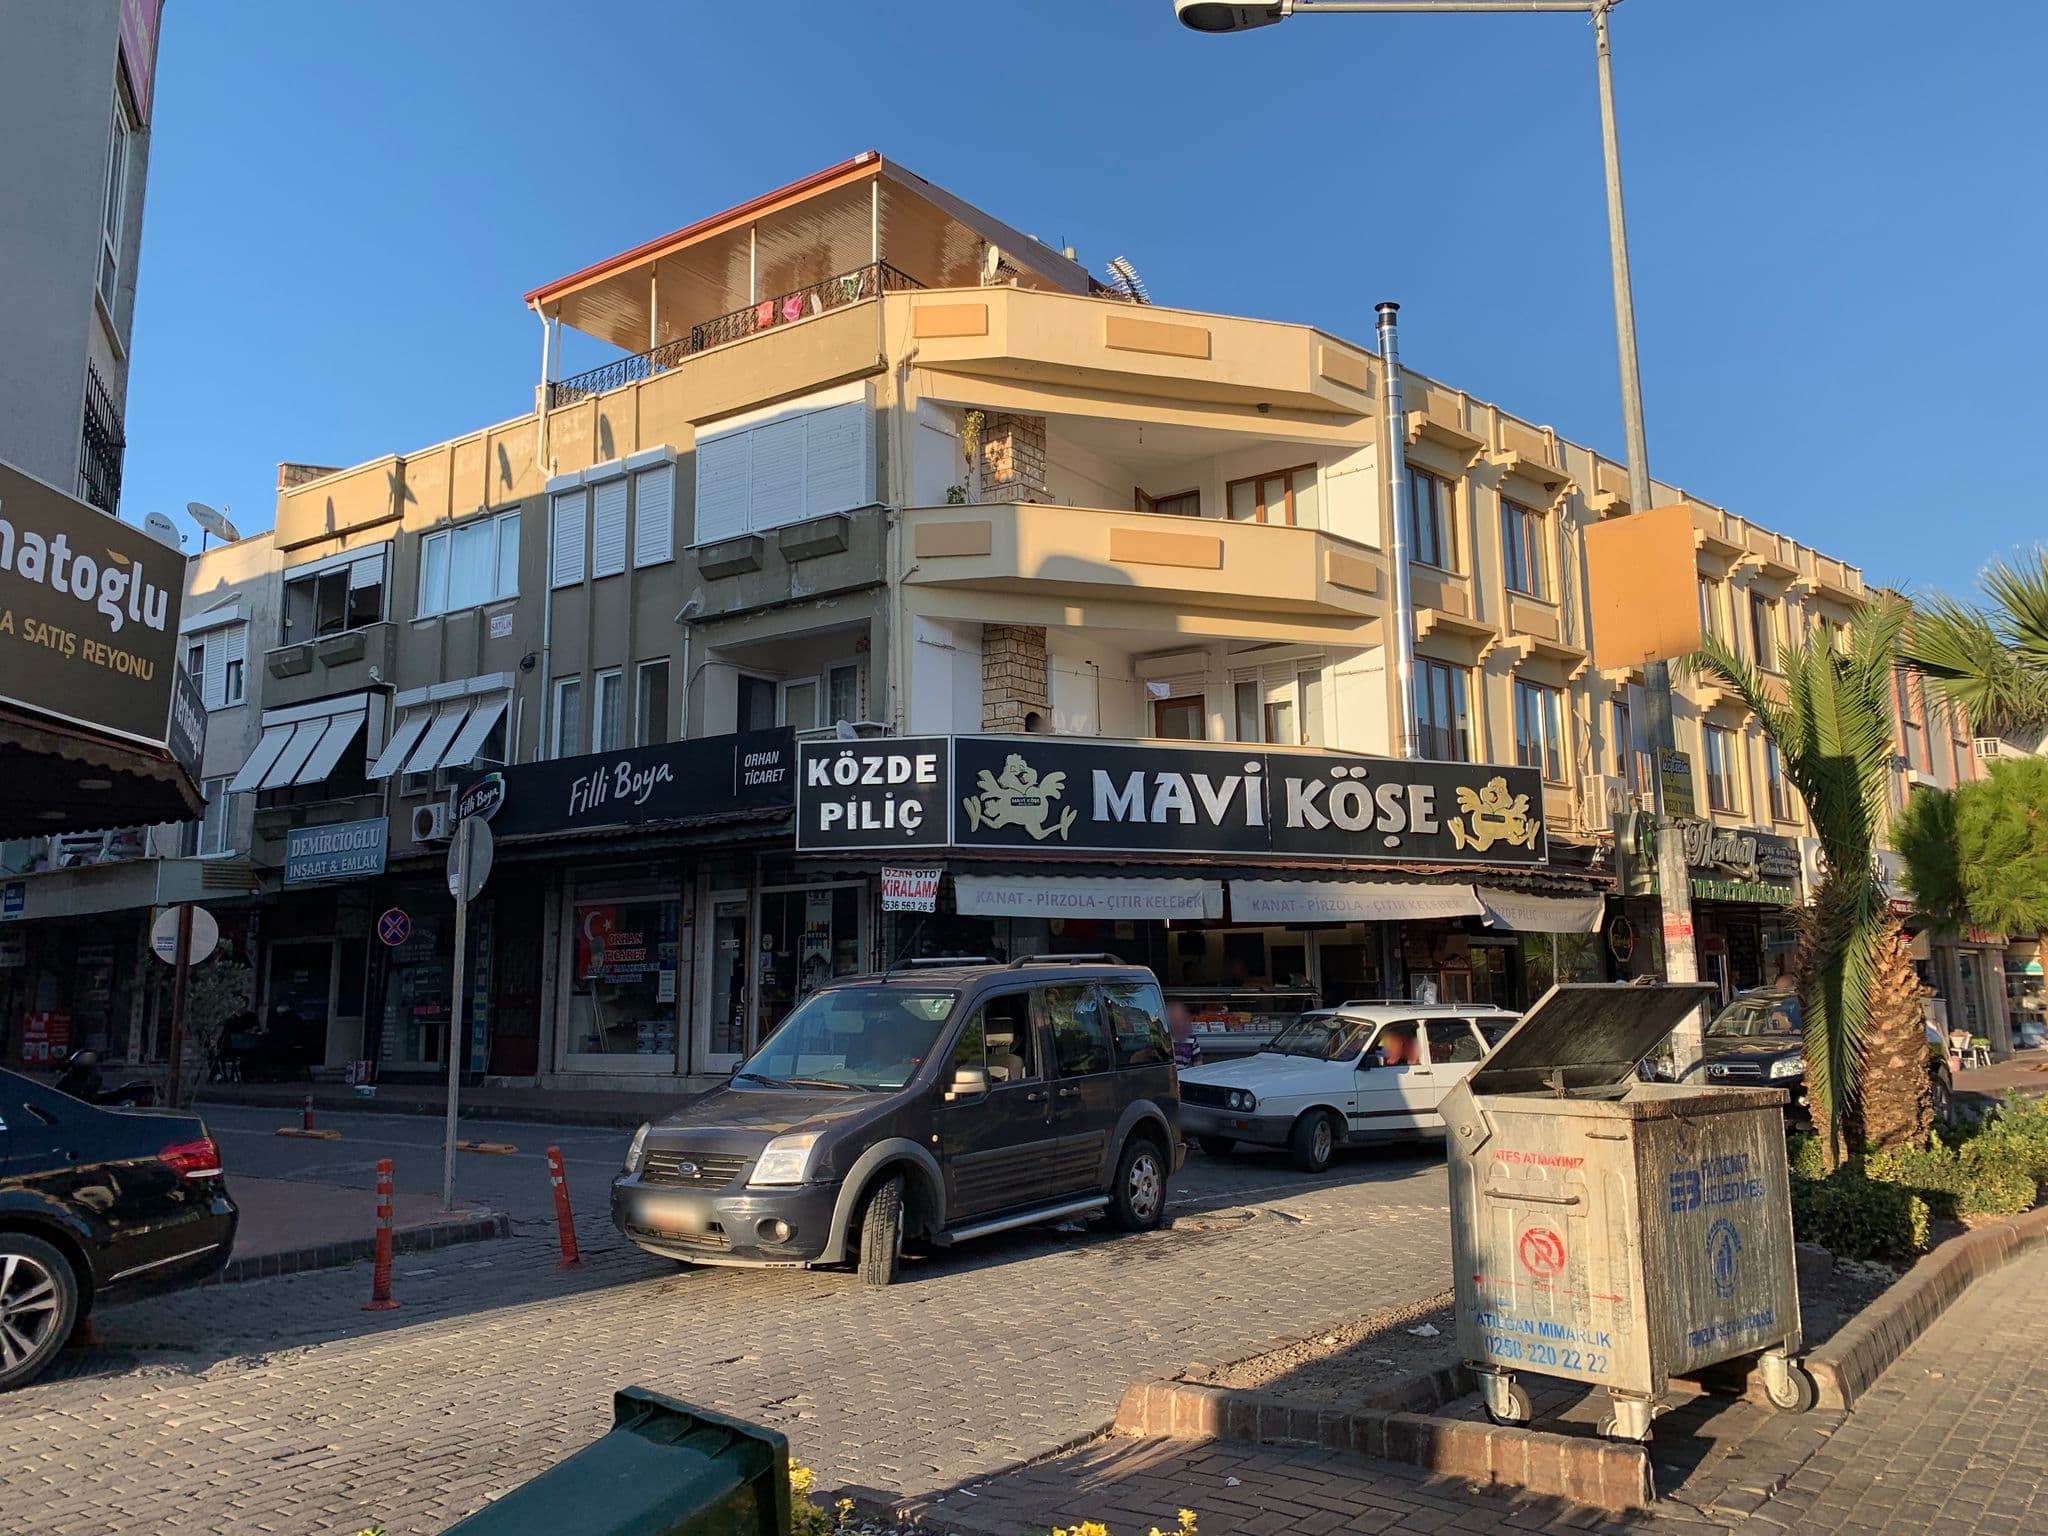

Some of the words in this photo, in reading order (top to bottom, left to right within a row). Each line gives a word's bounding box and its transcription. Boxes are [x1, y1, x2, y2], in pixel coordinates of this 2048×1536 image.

[23, 617, 77, 660] SATIŞ
[82, 638, 154, 681] REYONU
[744, 750, 780, 768] ORHAN
[808, 750, 938, 787] KÖZDE
[744, 766, 786, 786] TİCARET
[568, 766, 609, 816] Filli
[613, 760, 675, 805] Boya
[459, 795, 476, 819] Filli
[476, 787, 499, 808] Boya
[1091, 760, 1265, 825] MAVİ
[1284, 766, 1440, 848] KÖŞE
[820, 791, 925, 837] PİLİÇ
[291, 826, 382, 859] DEMİRCİOĞLU
[329, 860, 338, 873] &
[341, 854, 378, 872] EMLAK
[884, 868, 912, 878] OZAN
[915, 870, 937, 879] OTO
[882, 879, 938, 898] KİRALAMA
[901, 901, 916, 910] 563
[917, 902, 928, 911] 26
[976, 891, 1024, 905] KANAT
[1036, 890, 1095, 908] PİRZOLA
[1106, 894, 1143, 911] ÇITIR
[1145, 892, 1203, 908] KELEBEK
[1252, 899, 1297, 913] KANAT
[1307, 897, 1363, 912] PİRZOLA
[608, 931, 643, 945] ORHAN
[1523, 1154, 1585, 1169] ATMAYINIZ
[1476, 1312, 1535, 1335] ATILGAN
[1538, 1321, 1613, 1350] MIMARLIK
[1527, 1343, 1557, 1366] 220
[1562, 1348, 1582, 1371] 22
[1587, 1352, 1609, 1375] 22
